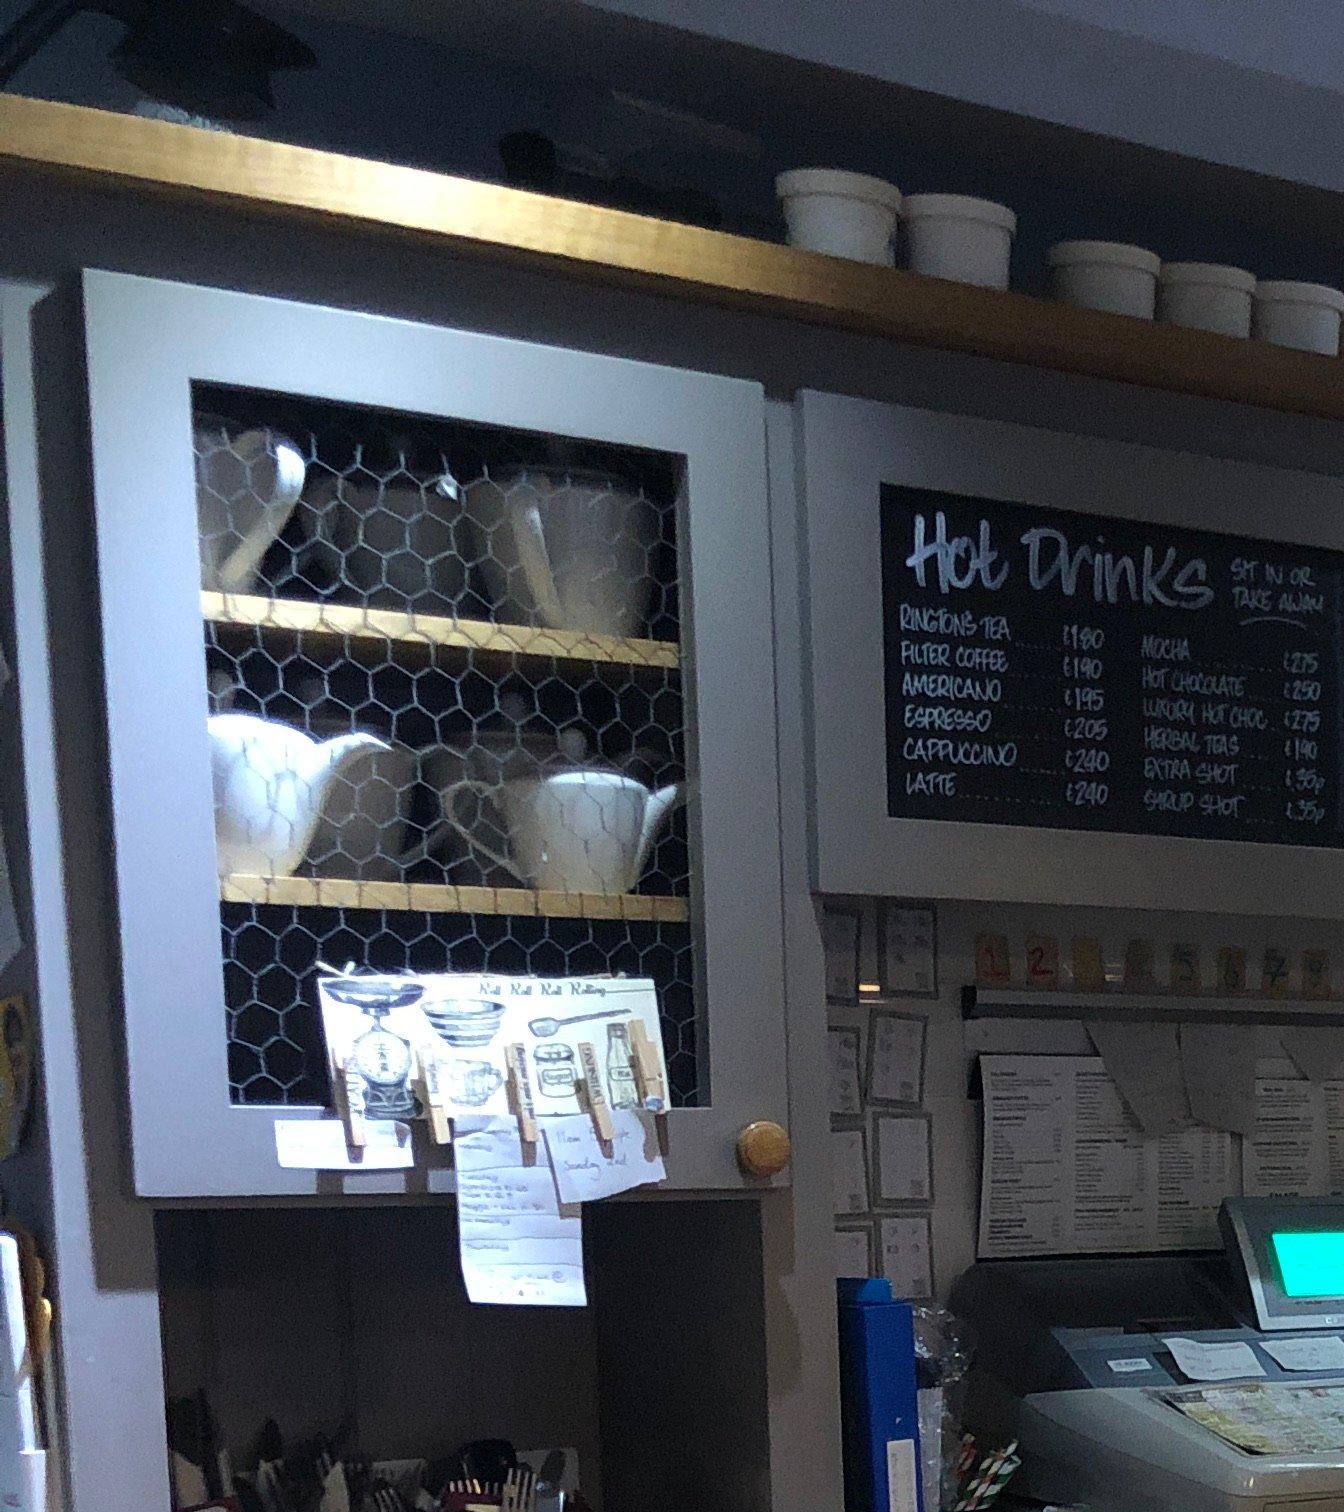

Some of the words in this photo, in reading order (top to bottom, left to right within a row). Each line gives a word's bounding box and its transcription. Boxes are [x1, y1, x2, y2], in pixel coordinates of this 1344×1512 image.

[906, 511, 1010, 593] Hot
[1020, 528, 1214, 609] Drinks
[981, 616, 1011, 641] TEA
[901, 641, 951, 667] FILTER
[956, 646, 1010, 673] COFFEE
[902, 671, 1002, 703] AMERICANO
[1142, 665, 1170, 689] HOT
[904, 704, 992, 732] ESPRESSO
[903, 737, 1018, 767] CAPPUCCINO
[906, 771, 957, 797] LATTE
